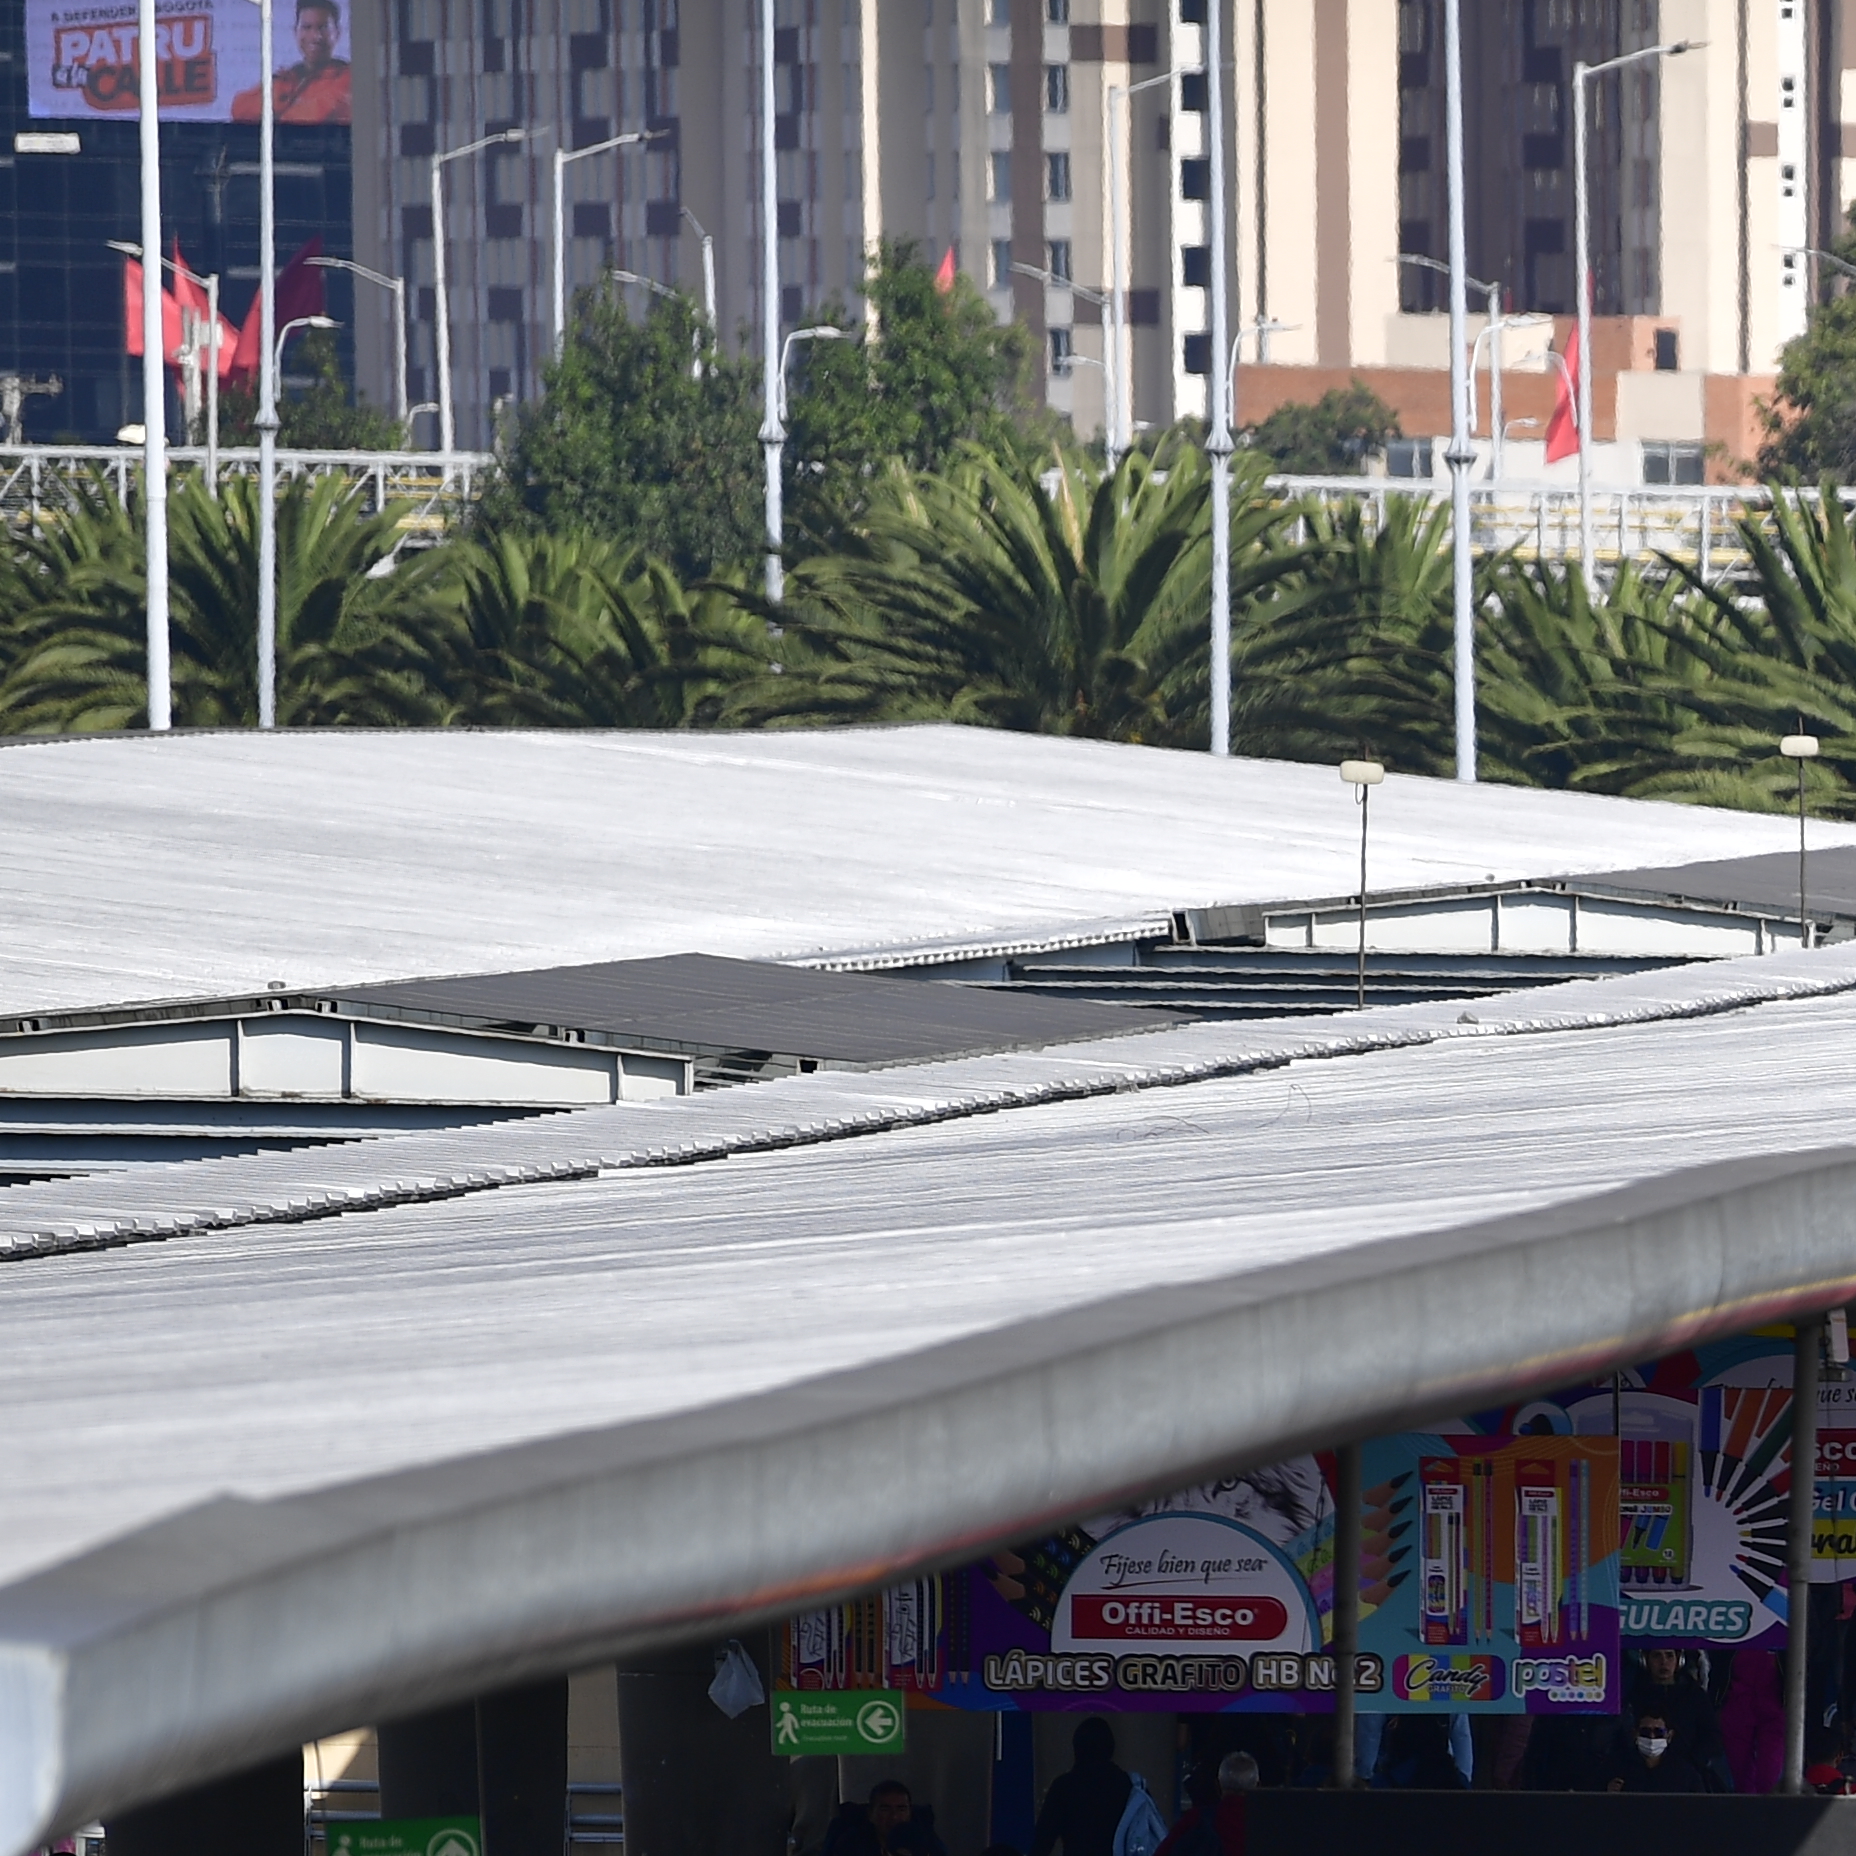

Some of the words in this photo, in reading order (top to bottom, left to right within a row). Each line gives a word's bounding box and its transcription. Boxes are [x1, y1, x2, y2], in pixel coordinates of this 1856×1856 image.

[61, 20, 205, 65] PATRU
[88, 60, 211, 101] CALE
[1816, 1390, 1842, 1403] ue
[1815, 1461, 1840, 1471] EÑO
[1160, 1549, 1196, 1574] bien
[1200, 1557, 1231, 1584] que
[1102, 1601, 1256, 1626] Offi-Esco
[1125, 1626, 1174, 1636] CALIDAD
[1177, 1627, 1185, 1636] Y
[1188, 1625, 1230, 1636] DISEÑO
[988, 1648, 1111, 1687] LÁPICES
[1121, 1660, 1241, 1687] GRAFITO
[1256, 1660, 1299, 1687] HB
[1405, 1659, 1488, 1696] Candy
[800, 1704, 823, 1715] Ruta
[824, 1703, 837, 1715] de
[800, 1715, 853, 1728] evacuación
